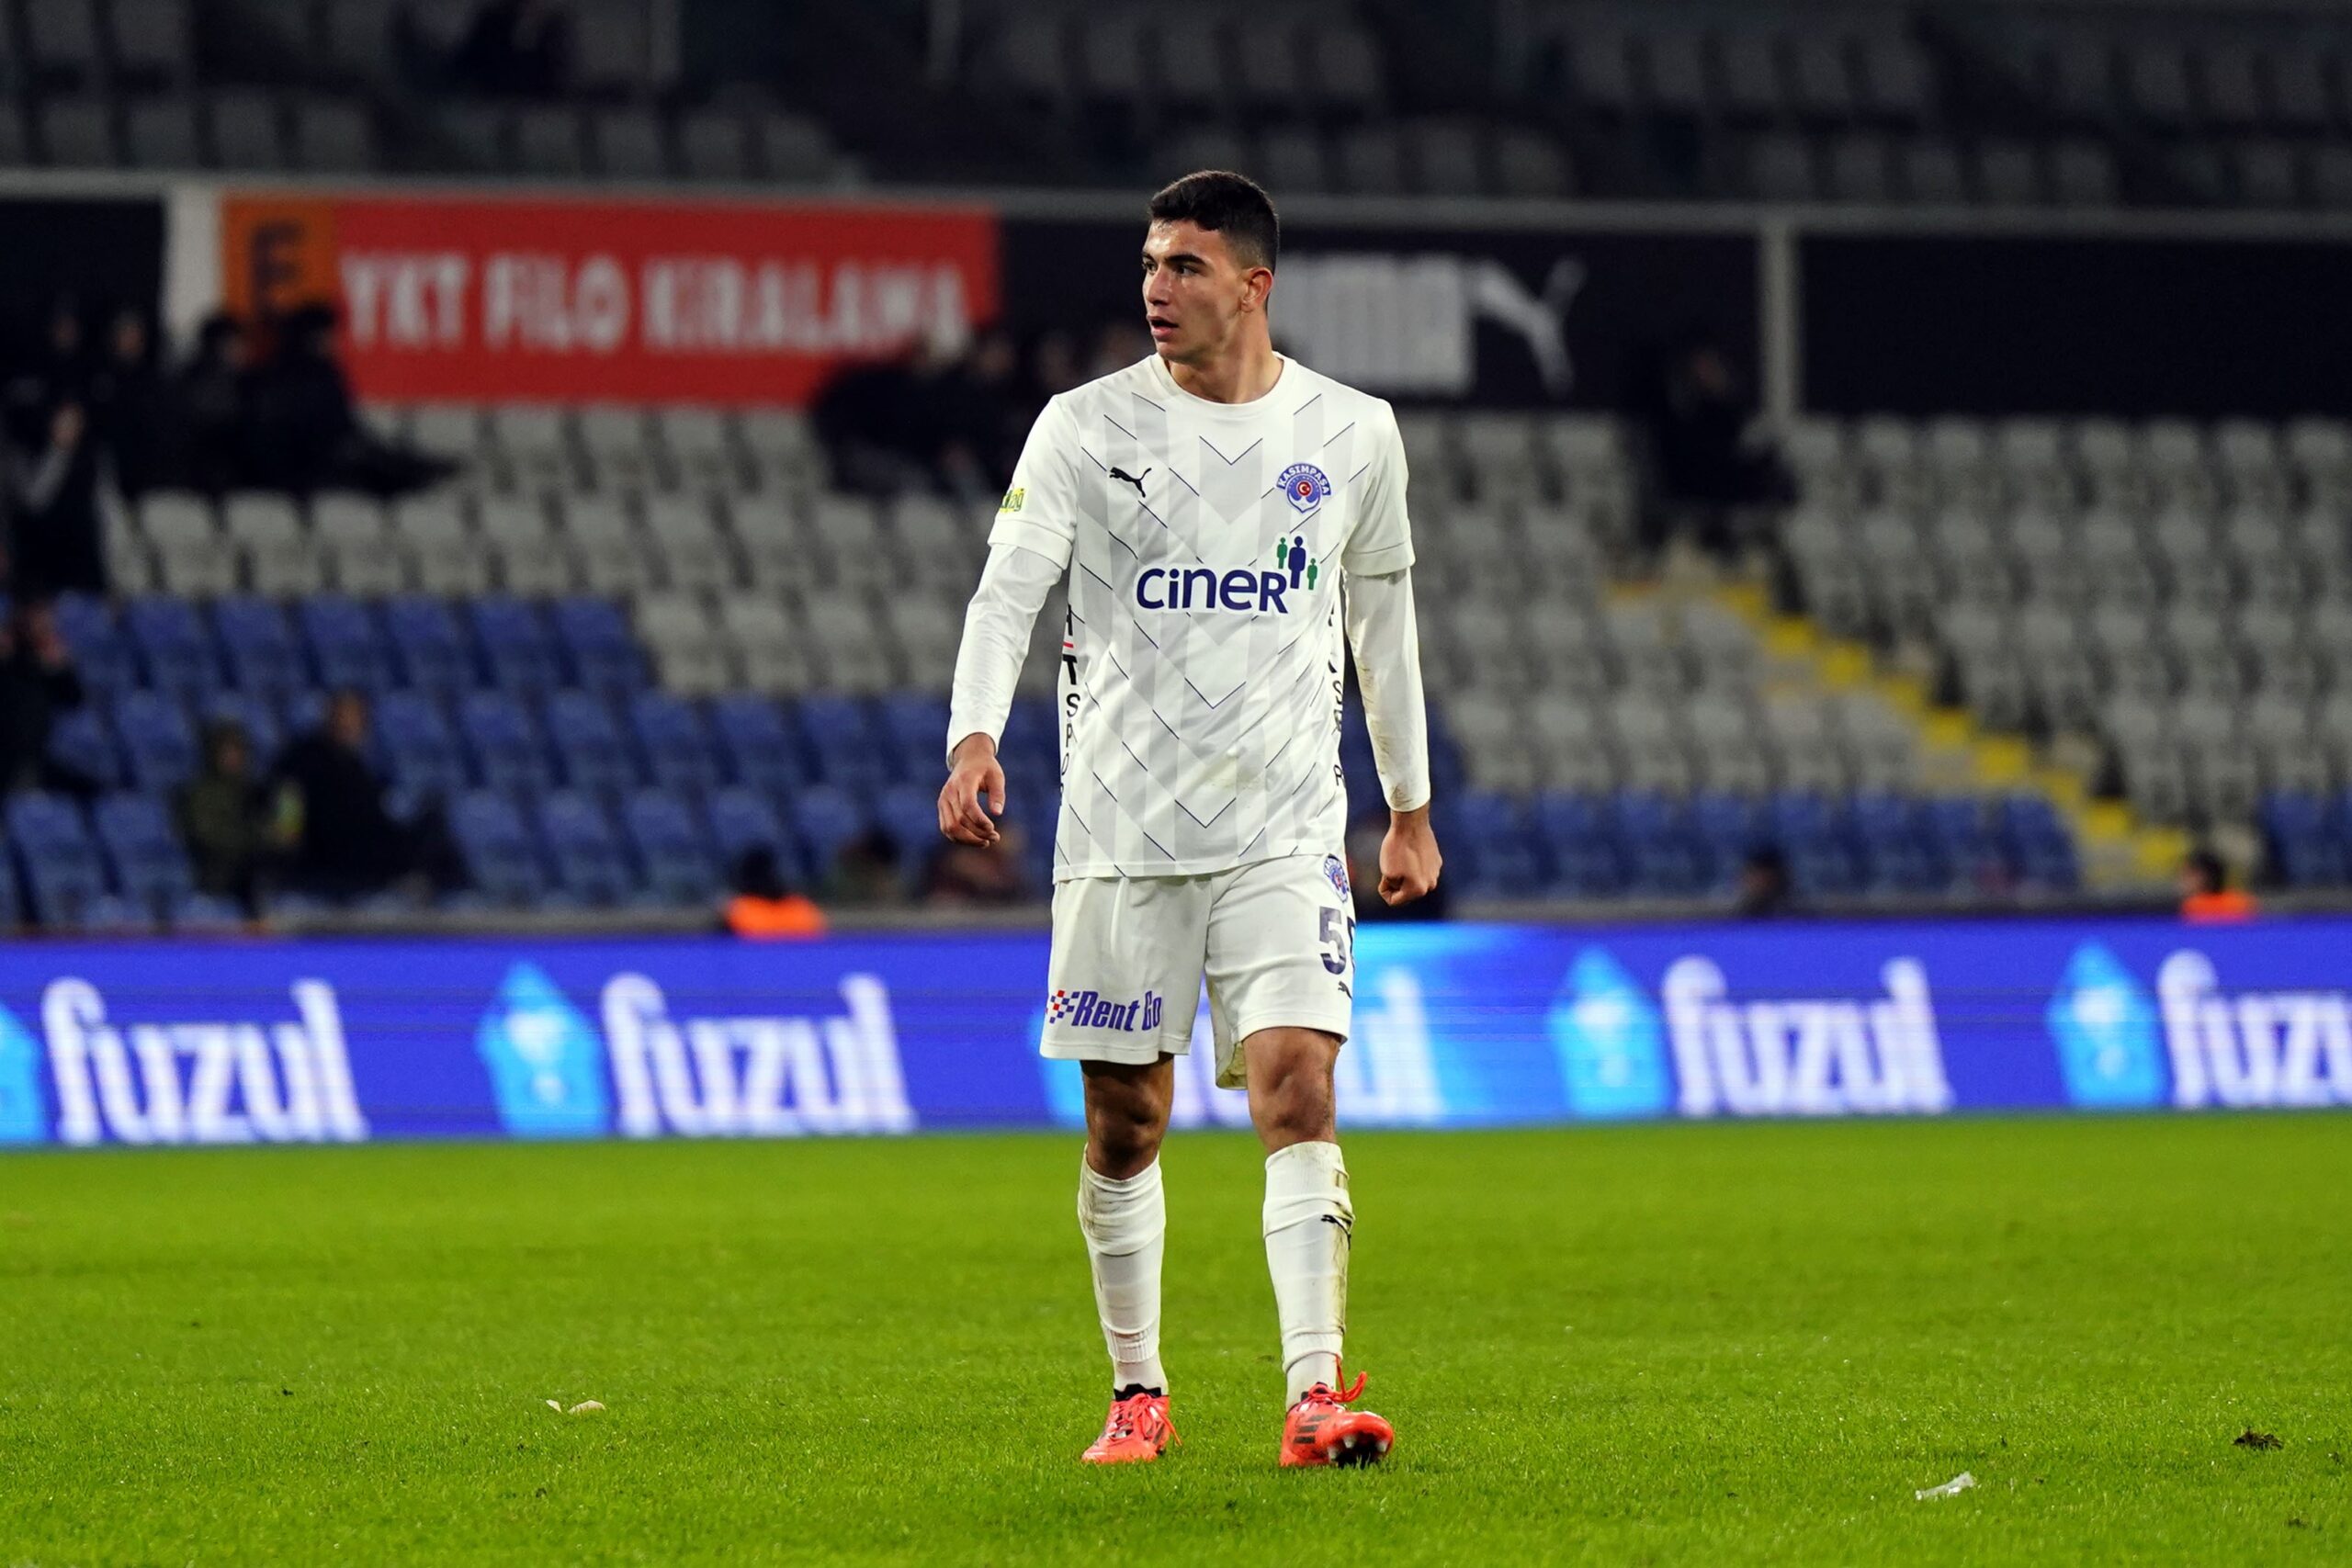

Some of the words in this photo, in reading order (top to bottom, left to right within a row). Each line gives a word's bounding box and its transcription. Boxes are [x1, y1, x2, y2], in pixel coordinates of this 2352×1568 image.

[339, 250, 470, 349] YKT
[1319, 906, 1356, 975] 5
[42, 978, 368, 1142] fuzul
[602, 974, 915, 1136] fuzul
[1071, 990, 1140, 1032] Rent
[1141, 990, 1161, 1031] Go
[1664, 958, 1951, 1116] fuzul
